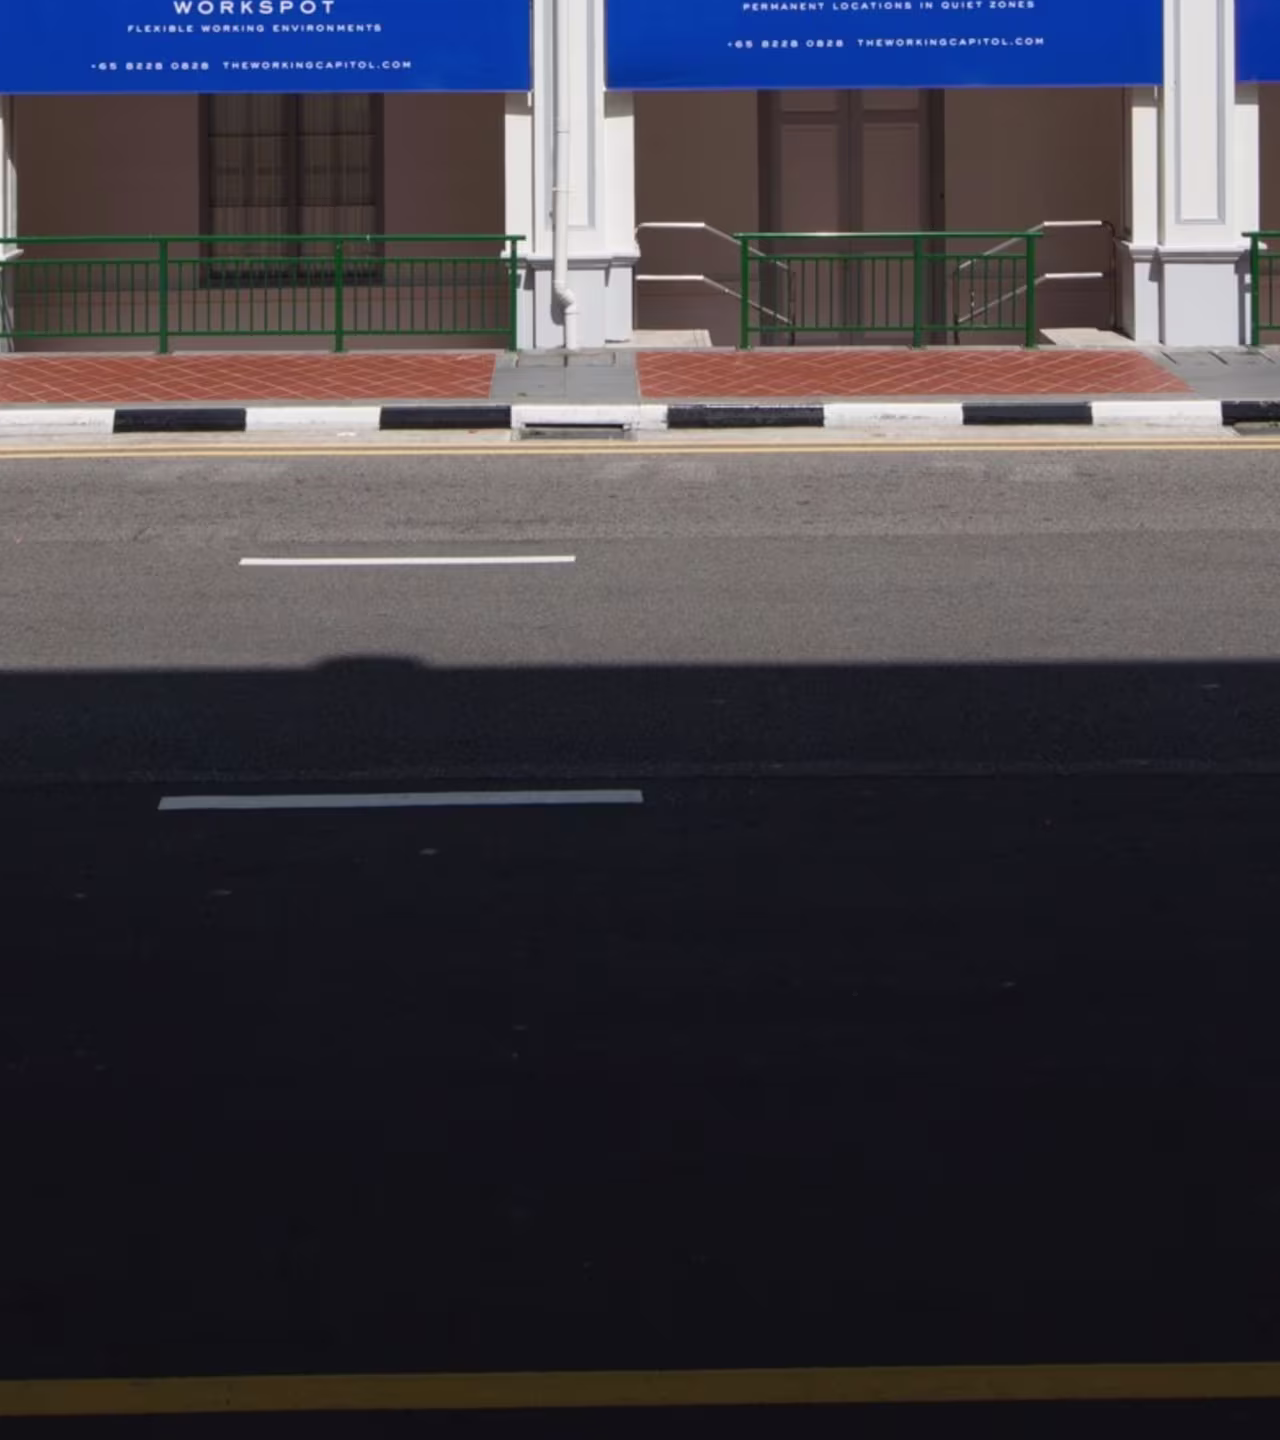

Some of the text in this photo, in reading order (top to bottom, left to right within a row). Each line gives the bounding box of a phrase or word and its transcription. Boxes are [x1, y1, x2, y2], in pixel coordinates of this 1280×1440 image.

[173, 0, 335, 15] WORKSPOT
[742, 0, 1035, 12] PERMANENT LOCATIONS IN QUIET ZONES
[127, 23, 382, 33] FLEXIBLE WORKING ENVIRONMENTS
[857, 37, 1044, 48] THEWORKINGCAPITOL.COM
[222, 60, 412, 70] THEWORKINGCAPITOL.COM
